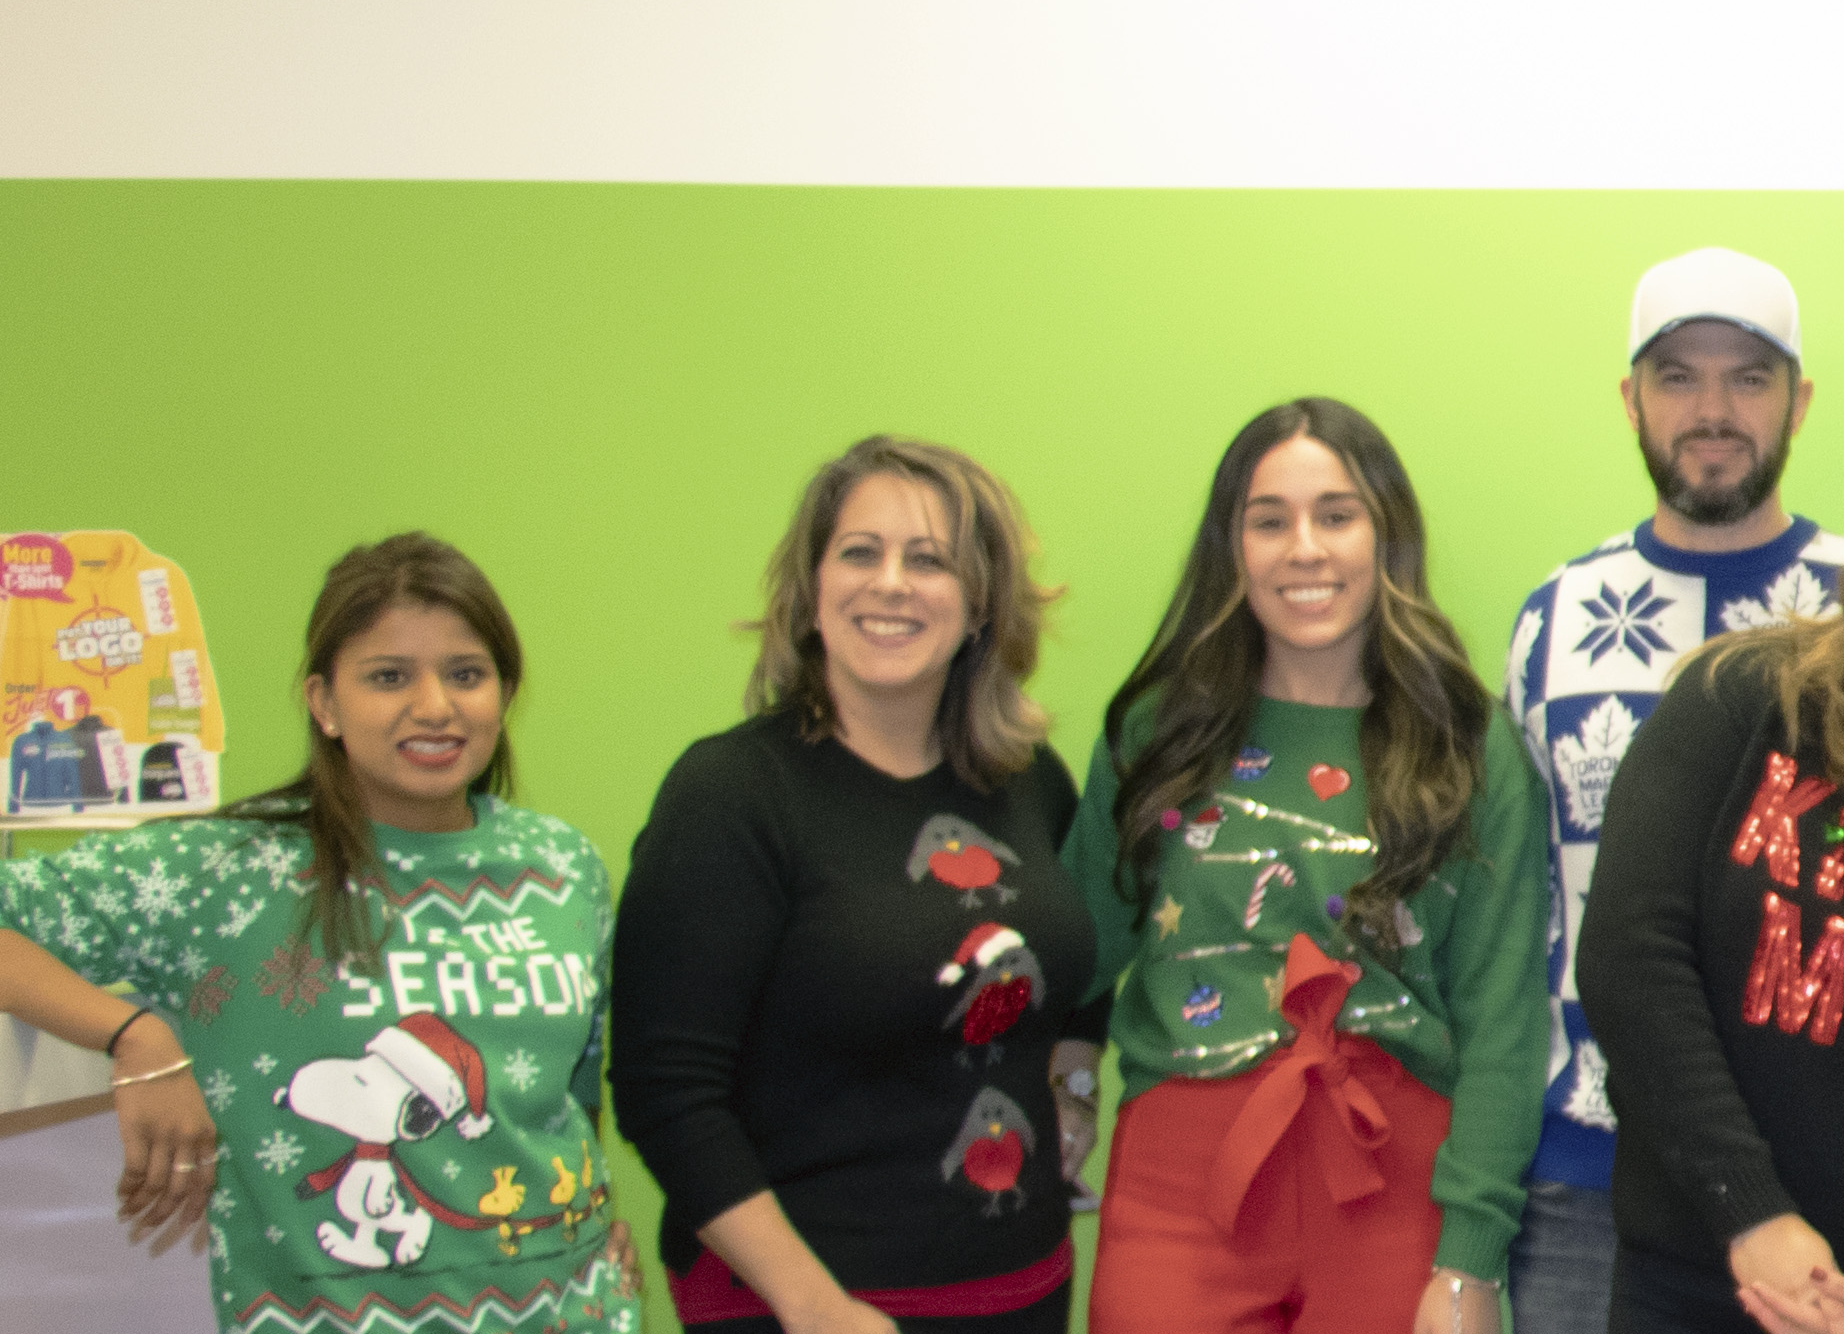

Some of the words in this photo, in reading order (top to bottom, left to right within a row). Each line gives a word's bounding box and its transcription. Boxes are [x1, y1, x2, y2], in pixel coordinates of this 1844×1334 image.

[3, 543, 52, 564] More
[81, 617, 131, 635] YOUR
[58, 632, 143, 661] LOGO
[55, 689, 76, 720] 1
[462, 917, 547, 953] THE
